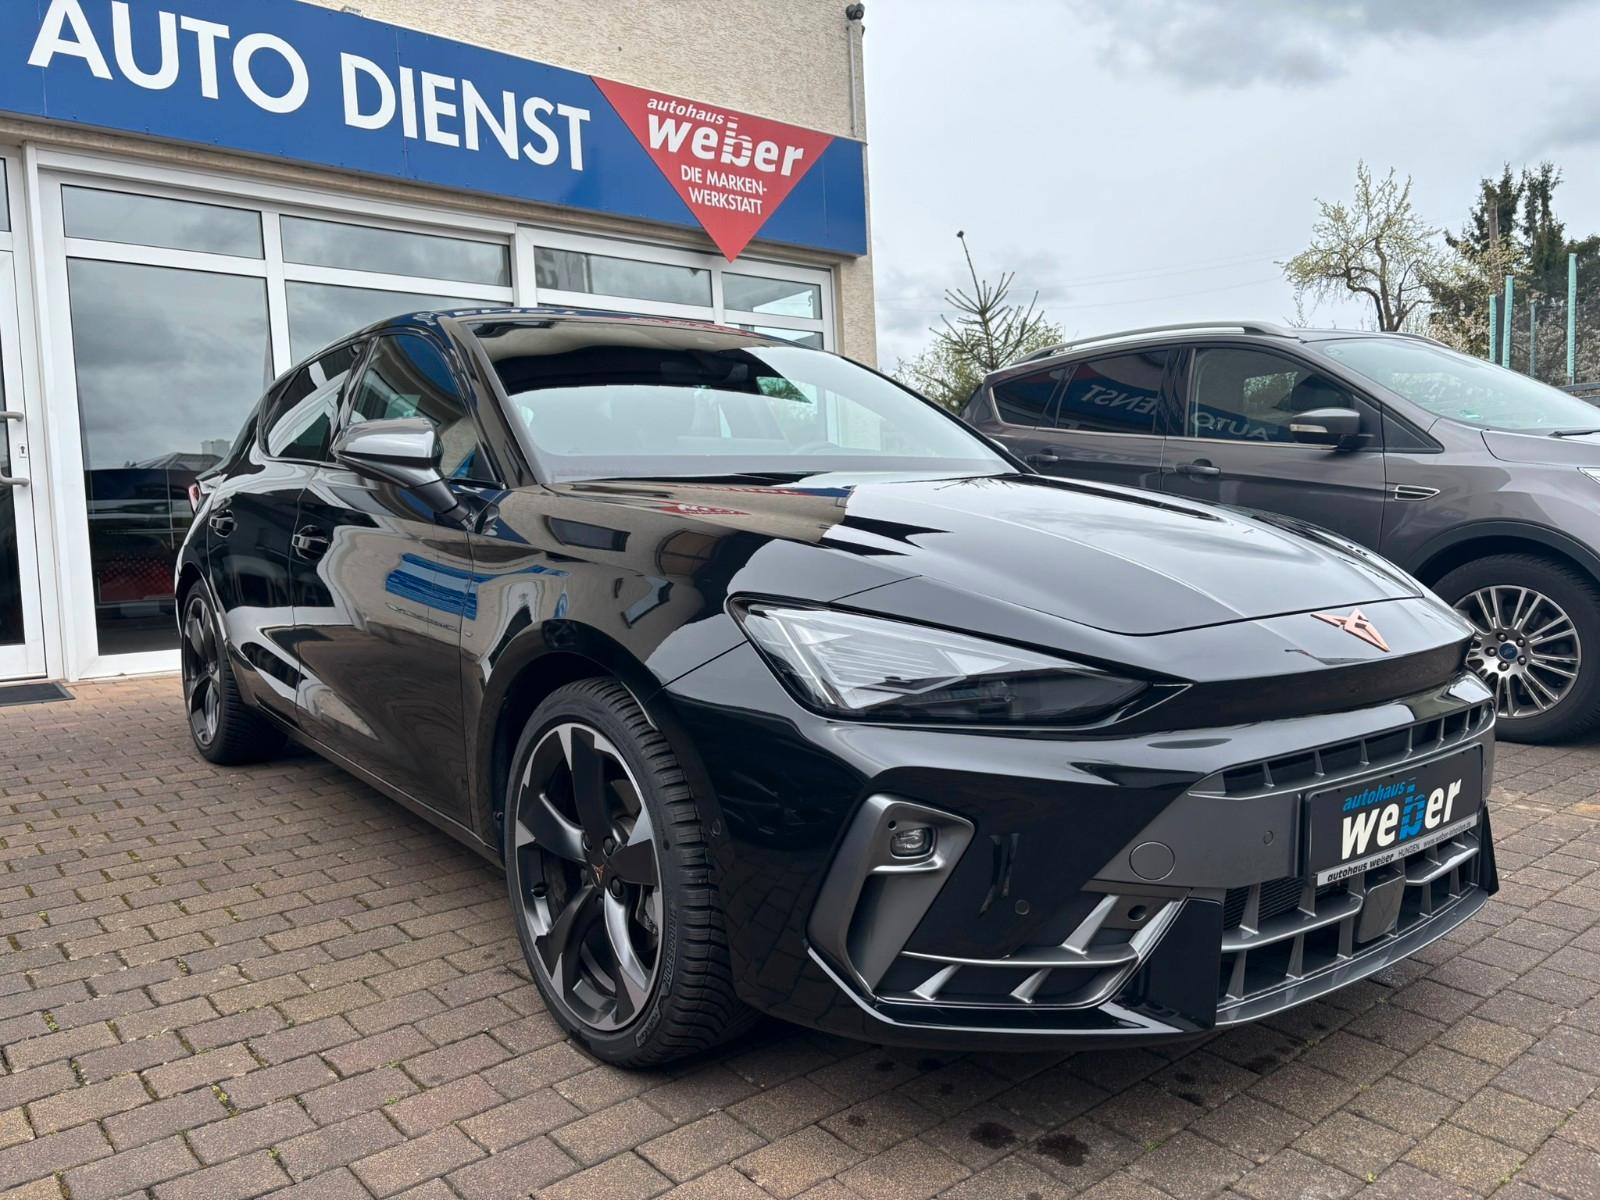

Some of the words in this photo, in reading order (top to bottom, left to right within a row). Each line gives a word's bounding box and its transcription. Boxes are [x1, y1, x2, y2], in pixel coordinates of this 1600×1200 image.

[27, 0, 309, 114] AUTO
[340, 51, 591, 171] DIENST
[647, 98, 725, 125] autohaus
[647, 114, 804, 177] weber
[680, 164, 703, 184] DIE
[706, 169, 767, 195] MARKEN-
[688, 186, 763, 215] WERKSTATT
[1343, 781, 1406, 813] autohaus
[1341, 777, 1462, 860] weber
[1327, 862, 1368, 882] autohaus
[1369, 853, 1394, 868] weber
